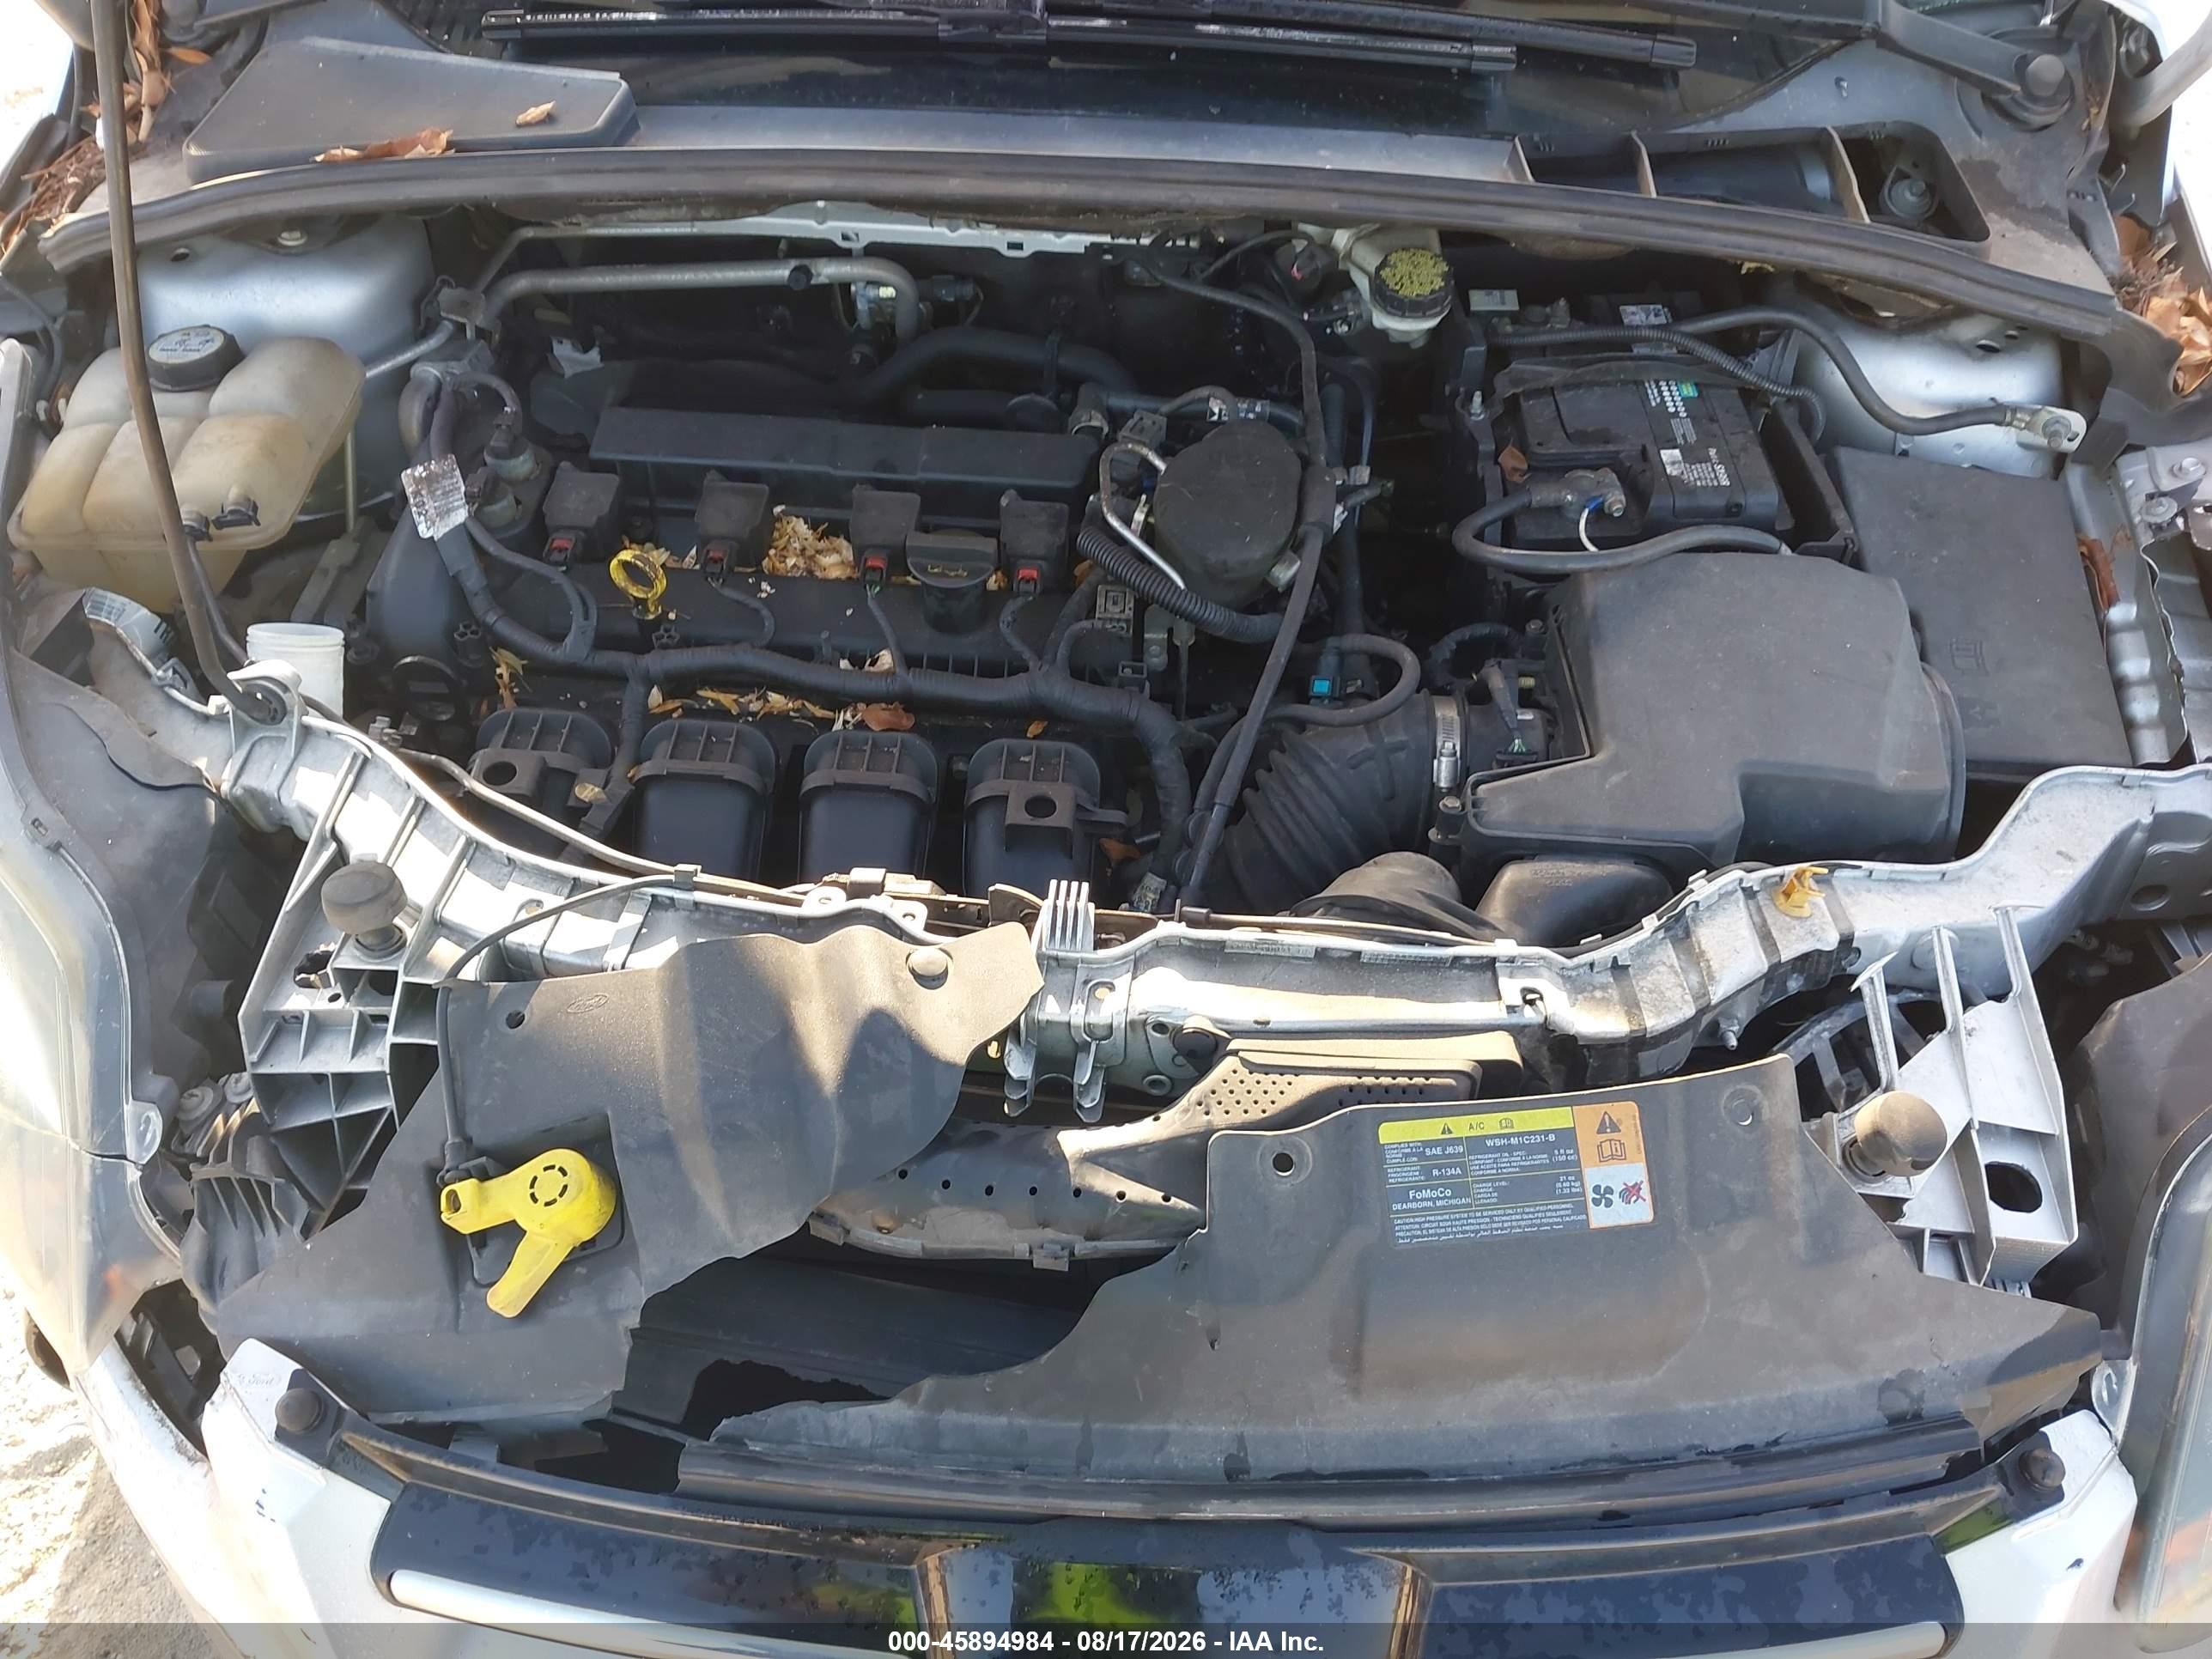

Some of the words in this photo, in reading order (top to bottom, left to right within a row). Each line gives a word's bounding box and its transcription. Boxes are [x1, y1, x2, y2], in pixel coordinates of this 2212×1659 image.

[1468, 1121, 1485, 1130] A/C
[1485, 1133, 1555, 1146] WSH-M1C231-B
[1425, 1146, 1443, 1156] SAE
[1443, 1144, 1463, 1154] J639
[1432, 1166, 1462, 1176] R-134A
[1408, 1186, 1451, 1200] FoMoCo
[1392, 1200, 1435, 1210] DEARBORN,
[1436, 1197, 1471, 1206] MICHIGAN
